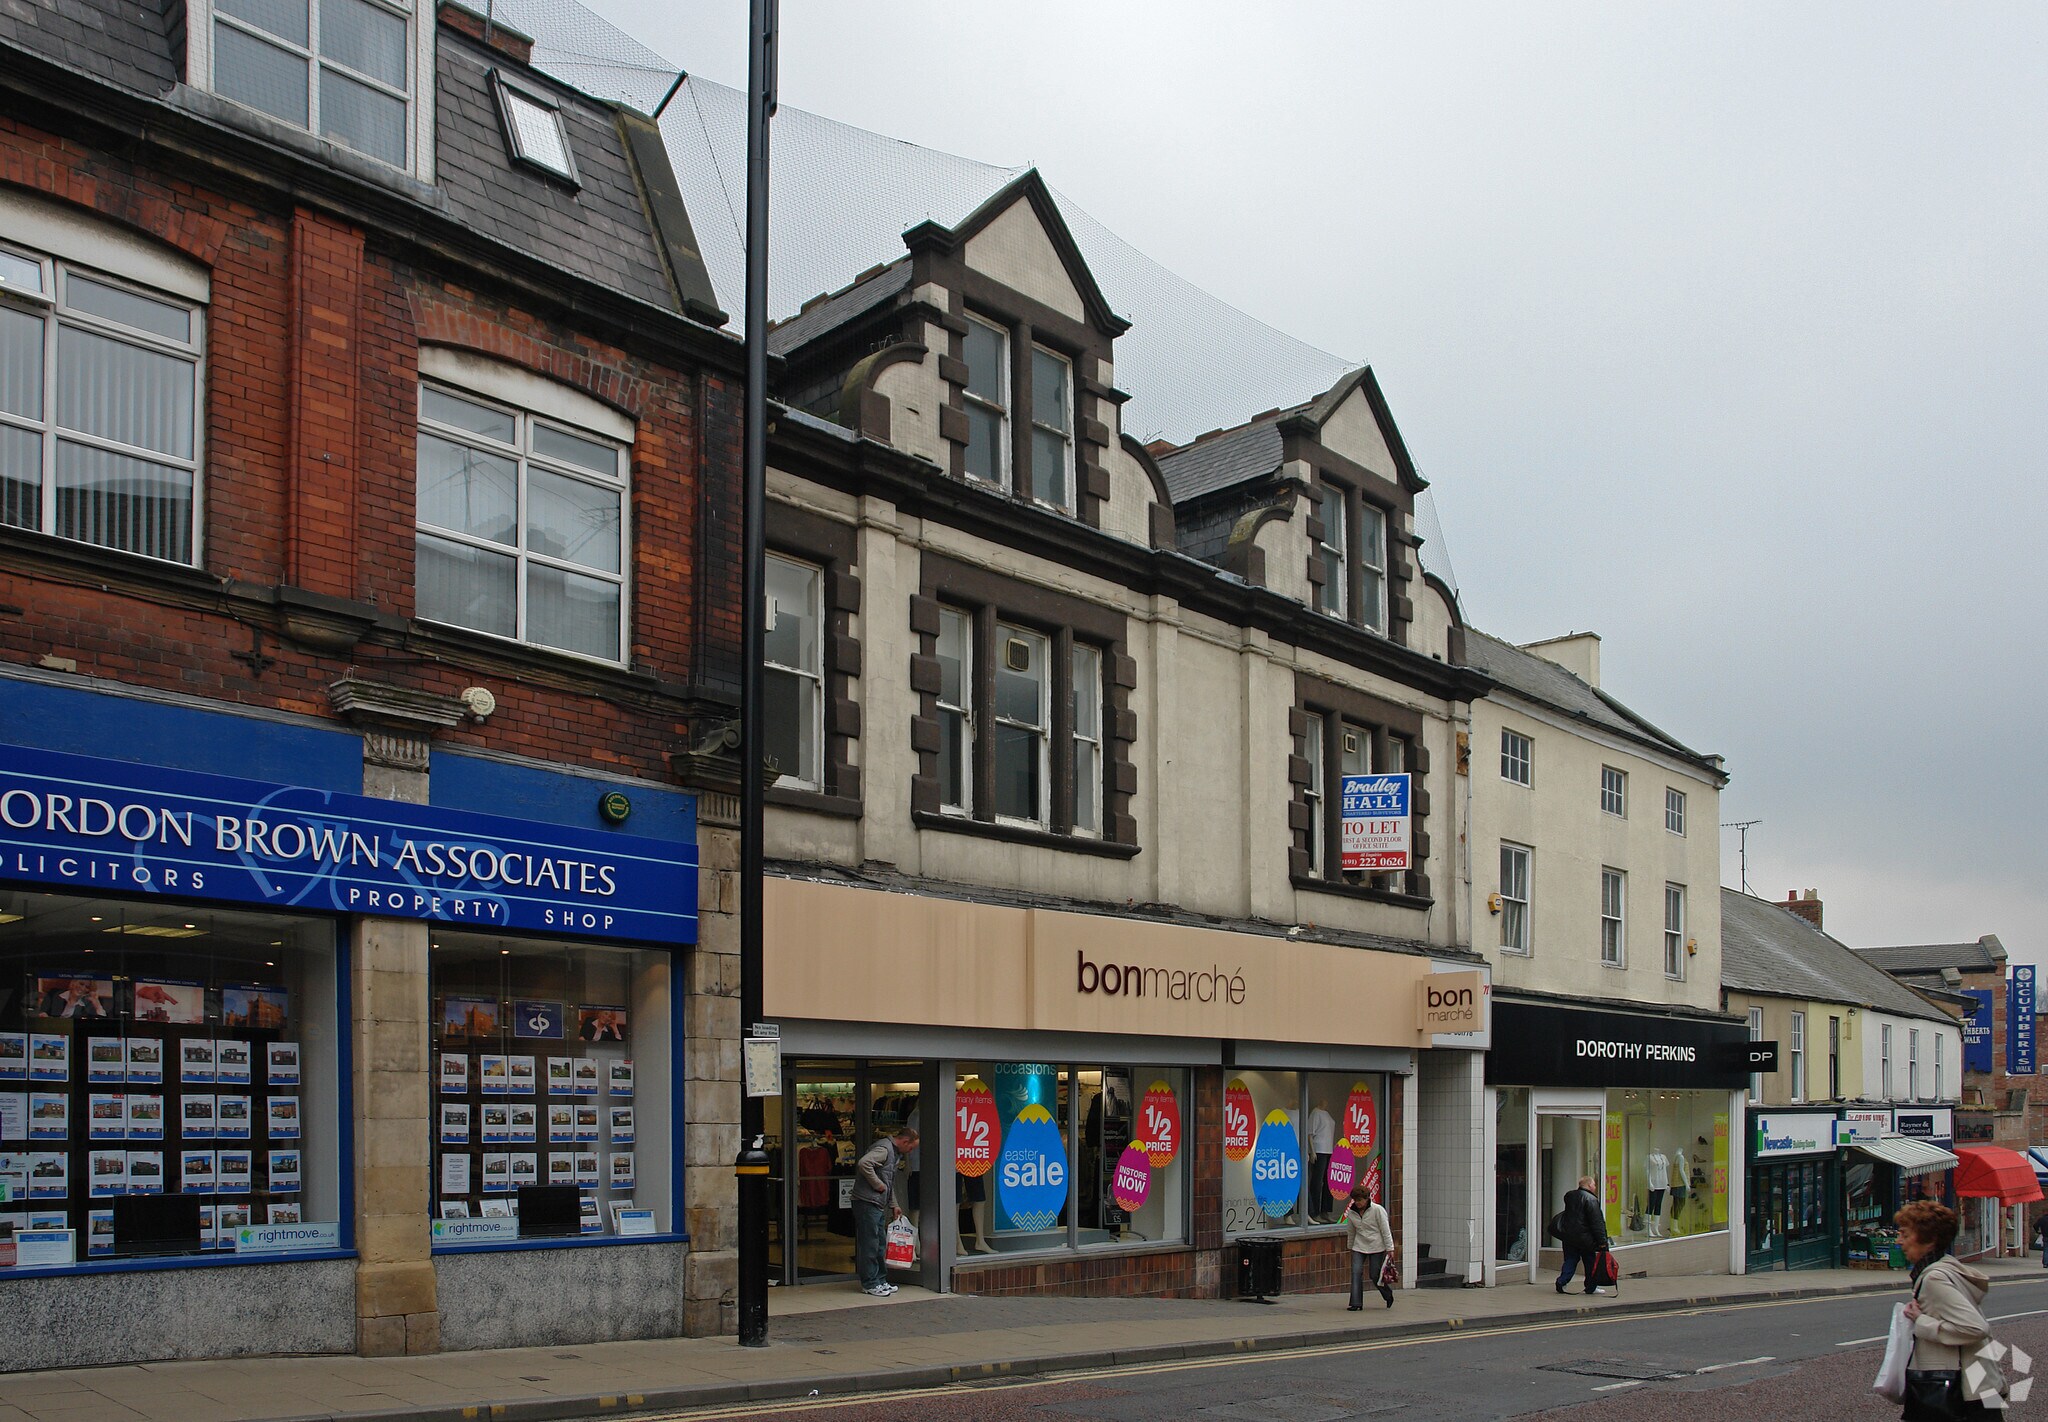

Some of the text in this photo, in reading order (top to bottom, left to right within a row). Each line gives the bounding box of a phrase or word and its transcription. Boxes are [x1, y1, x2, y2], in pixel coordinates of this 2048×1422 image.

[1344, 777, 1402, 795] Bradley
[1343, 821, 1400, 834] TO LET
[216, 815, 380, 868] BROWN
[393, 839, 616, 896] ASSOCIATES
[1359, 858, 1377, 866] 222
[1380, 857, 1404, 866] 0626
[350, 888, 499, 918] PROPERTY
[545, 909, 614, 930] SHOP
[1427, 986, 1473, 1008] bon
[1427, 1007, 1473, 1021] marché
[2017, 988, 2031, 1065] CUTHBERTS
[1576, 1039, 1696, 1062] DOROTHY PERKINS
[1750, 1052, 1773, 1062] DP
[995, 1063, 1057, 1076] occasions
[957, 1096, 993, 1105] many items
[957, 1106, 990, 1147] 1/2
[1145, 1105, 1172, 1141] 1/2
[1225, 1103, 1249, 1137] 1/2
[1350, 1103, 1370, 1135] 1/2
[1900, 1121, 1921, 1129] Rayner
[1606, 1124, 1620, 1139] ALE
[1900, 1127, 1931, 1135] Boothroyd
[1225, 1136, 1249, 1147] PRICE
[1350, 1134, 1370, 1144] PRICE
[1764, 1136, 1793, 1150] Newcastle
[957, 1148, 990, 1159] PRICE
[1005, 1148, 1039, 1161] easter
[1145, 1142, 1172, 1152] PRICE
[1256, 1148, 1280, 1159] easter
[1003, 1154, 1064, 1187] sale
[1119, 1165, 1147, 1181] INSTORE
[1255, 1152, 1299, 1181] sale
[1331, 1161, 1352, 1173] INSTORE
[1117, 1174, 1146, 1194] NOW
[1330, 1169, 1352, 1184] NOW
[1713, 1168, 1727, 1194] £5
[258, 1229, 335, 1244] rightmove.co.uk
